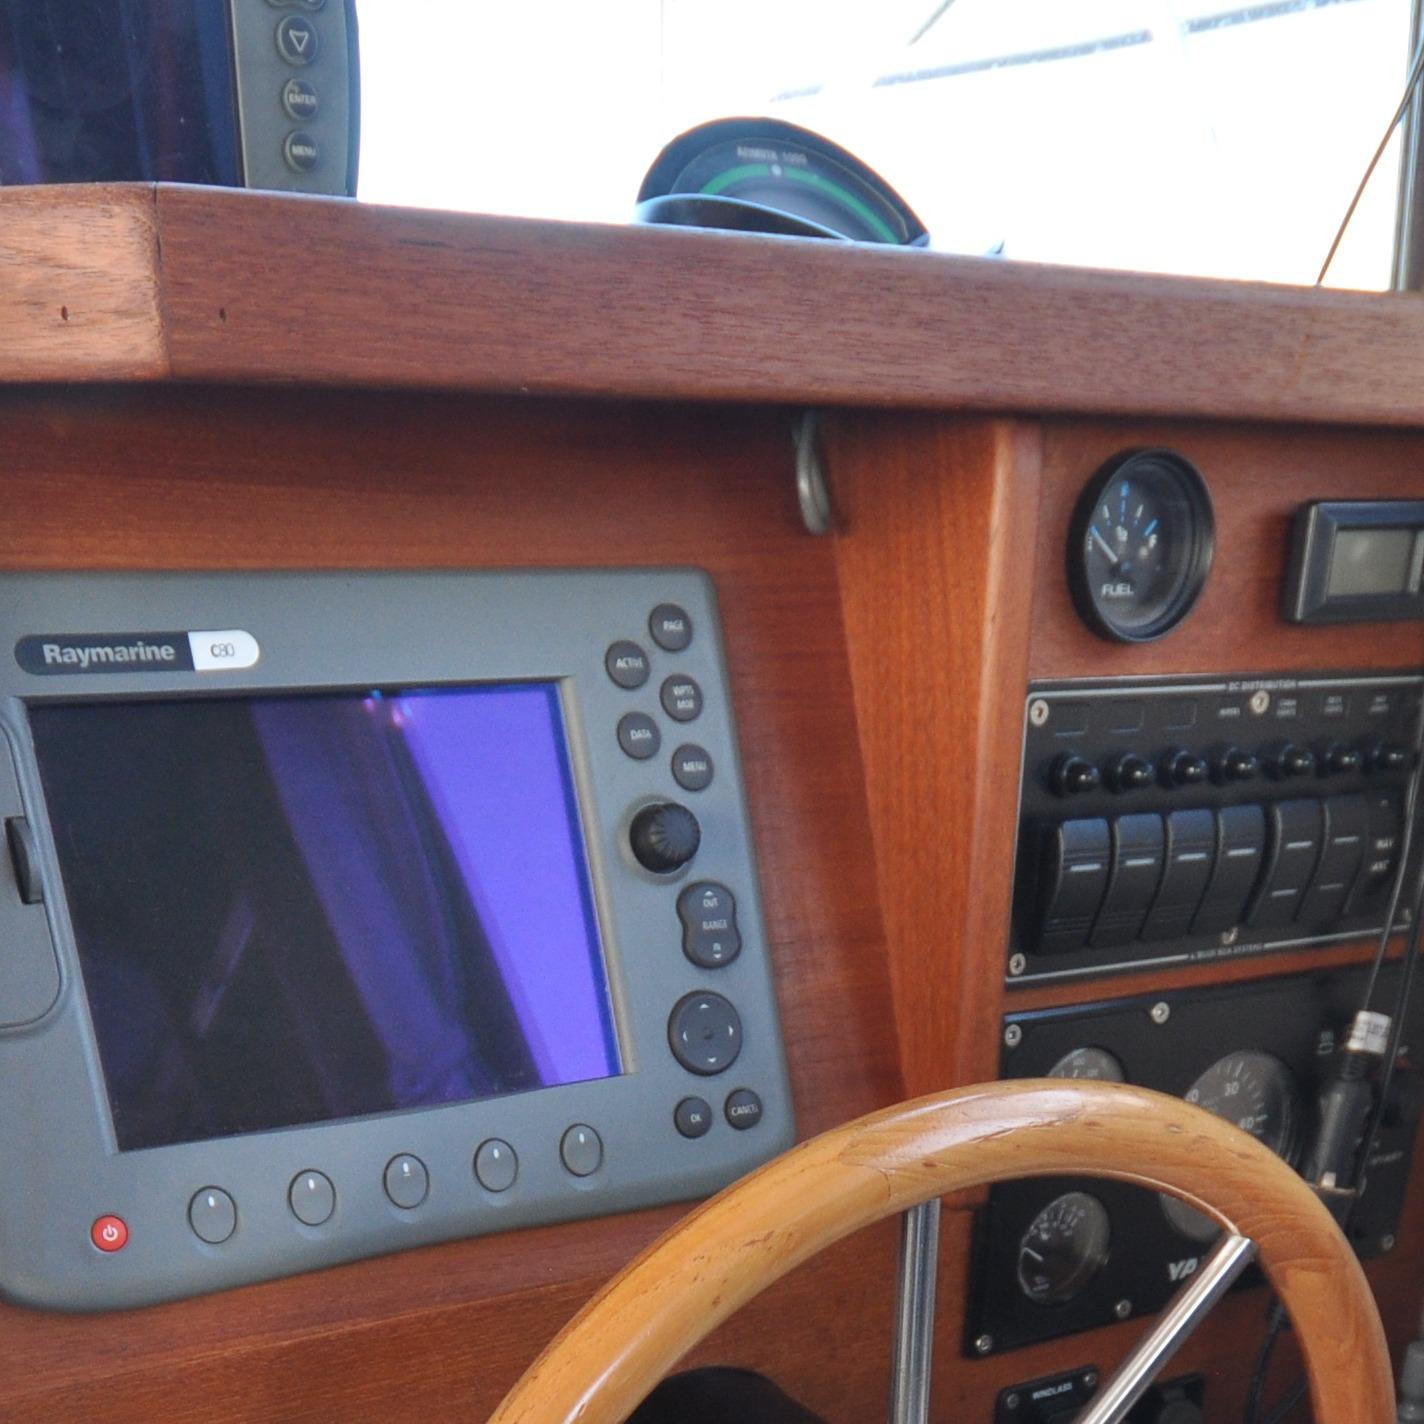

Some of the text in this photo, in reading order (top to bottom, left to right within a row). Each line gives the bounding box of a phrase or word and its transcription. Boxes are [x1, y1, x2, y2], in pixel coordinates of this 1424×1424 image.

[1101, 583, 1134, 596] FUEL
[663, 619, 684, 631] PAGE
[42, 641, 176, 668] Raymarine
[616, 656, 644, 669] ACTIVE
[630, 729, 652, 741] DATA
[683, 760, 707, 772] MENU
[703, 898, 718, 908] OUT
[1224, 1081, 1239, 1097] 30
[731, 1104, 759, 1116] CANCEL
[691, 1112, 702, 1123] OK
[1032, 1381, 1073, 1400] WINDLASS
